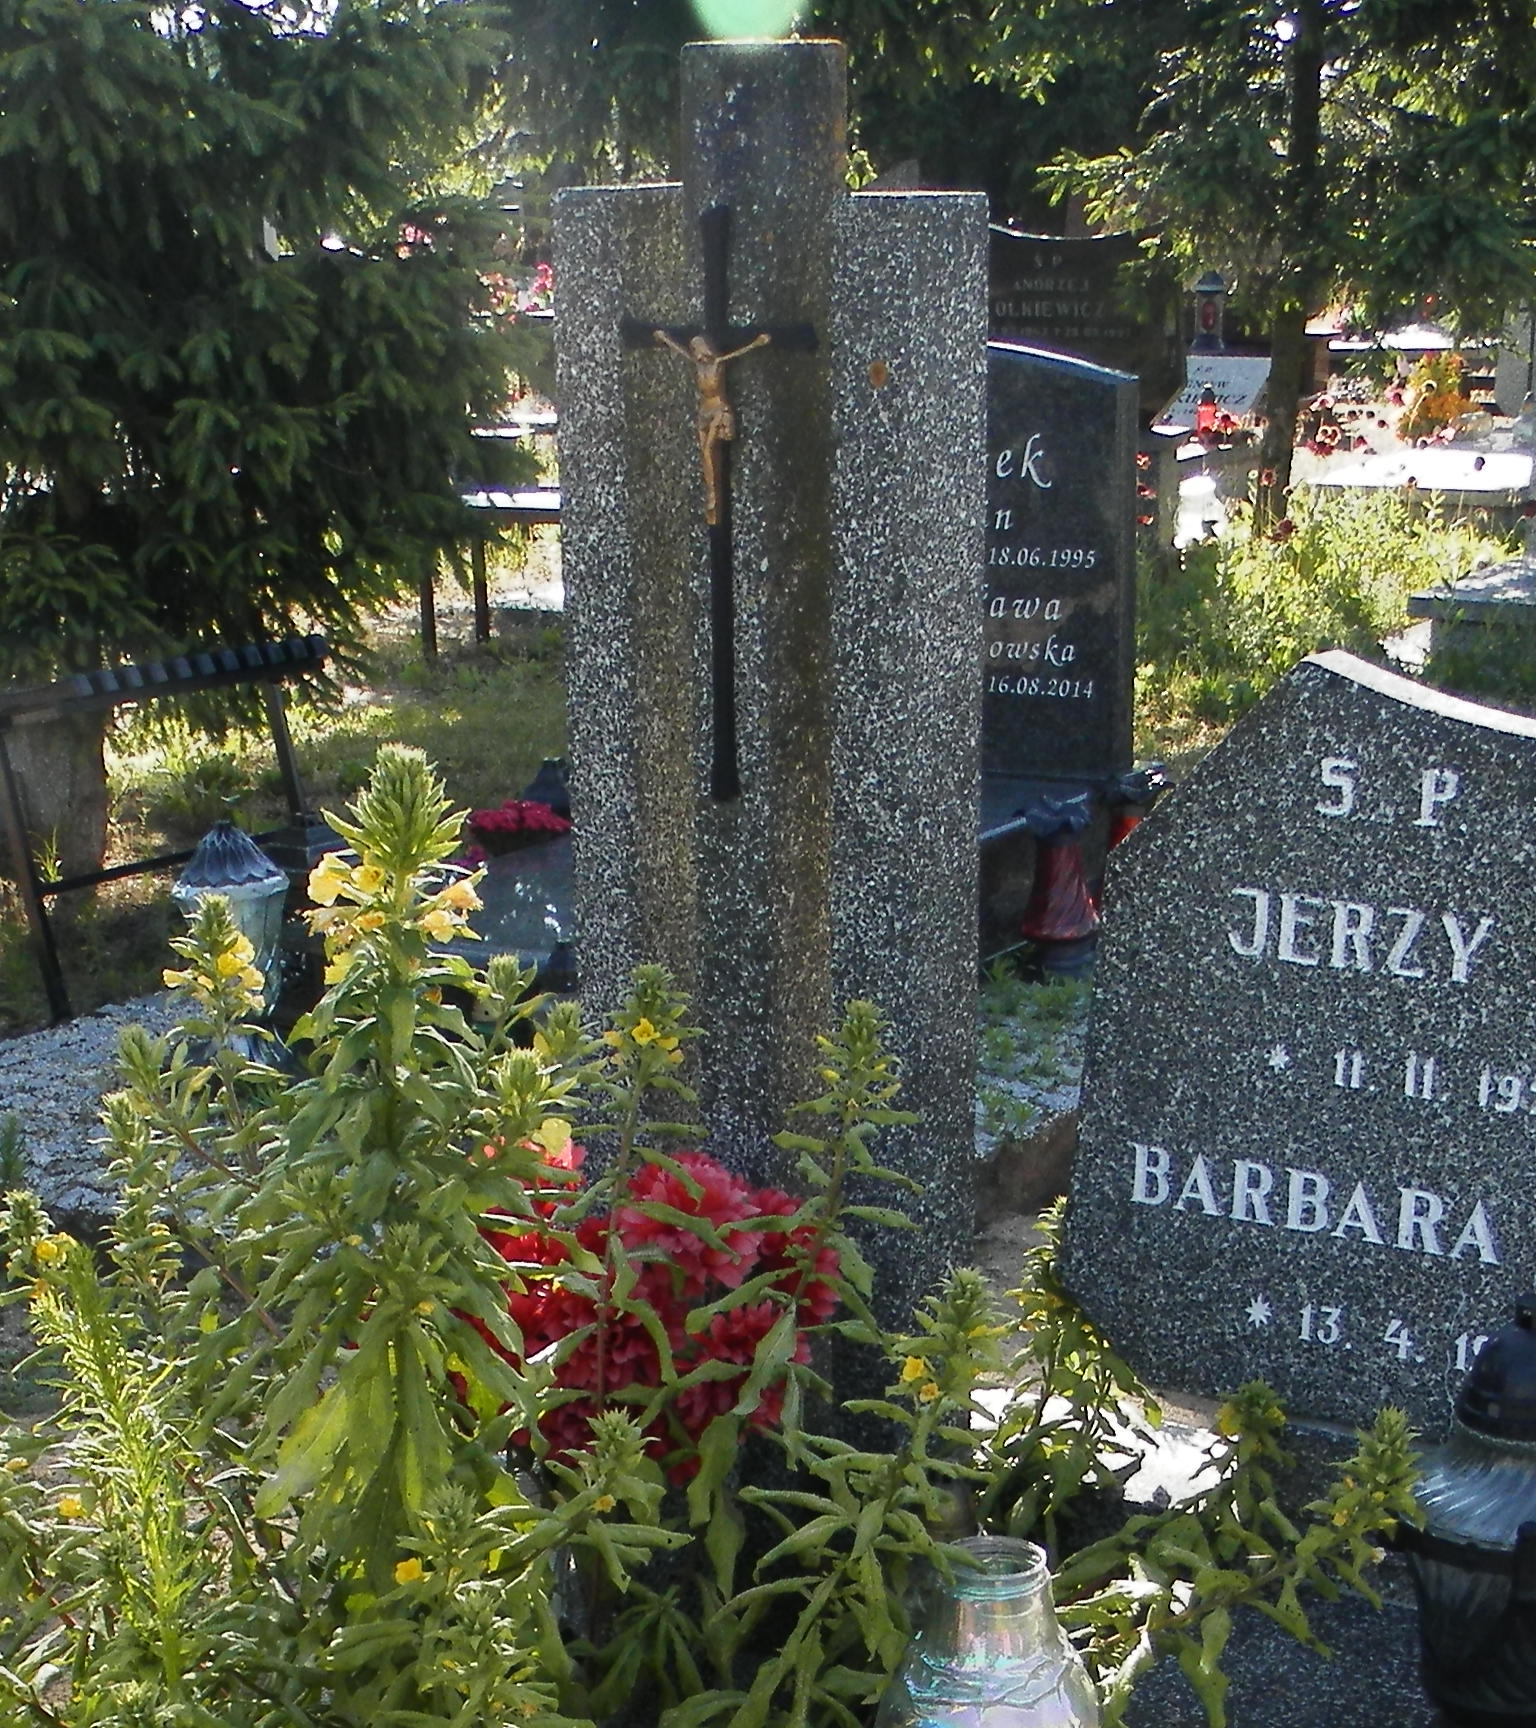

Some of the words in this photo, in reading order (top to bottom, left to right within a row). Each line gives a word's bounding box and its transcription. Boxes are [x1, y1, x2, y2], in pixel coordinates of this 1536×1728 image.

[1013, 277, 1090, 292] ANDRZEJ
[994, 300, 1106, 320] OŁKIEWICZ
[995, 433, 1052, 489] ek
[987, 546, 1097, 570] 18.06.1995
[988, 595, 1063, 622] awa
[988, 633, 1076, 668] owska
[987, 674, 1095, 700] 16.08.2014
[1228, 886, 1495, 984] JERZY
[1128, 1141, 1502, 1267] BARBARA
